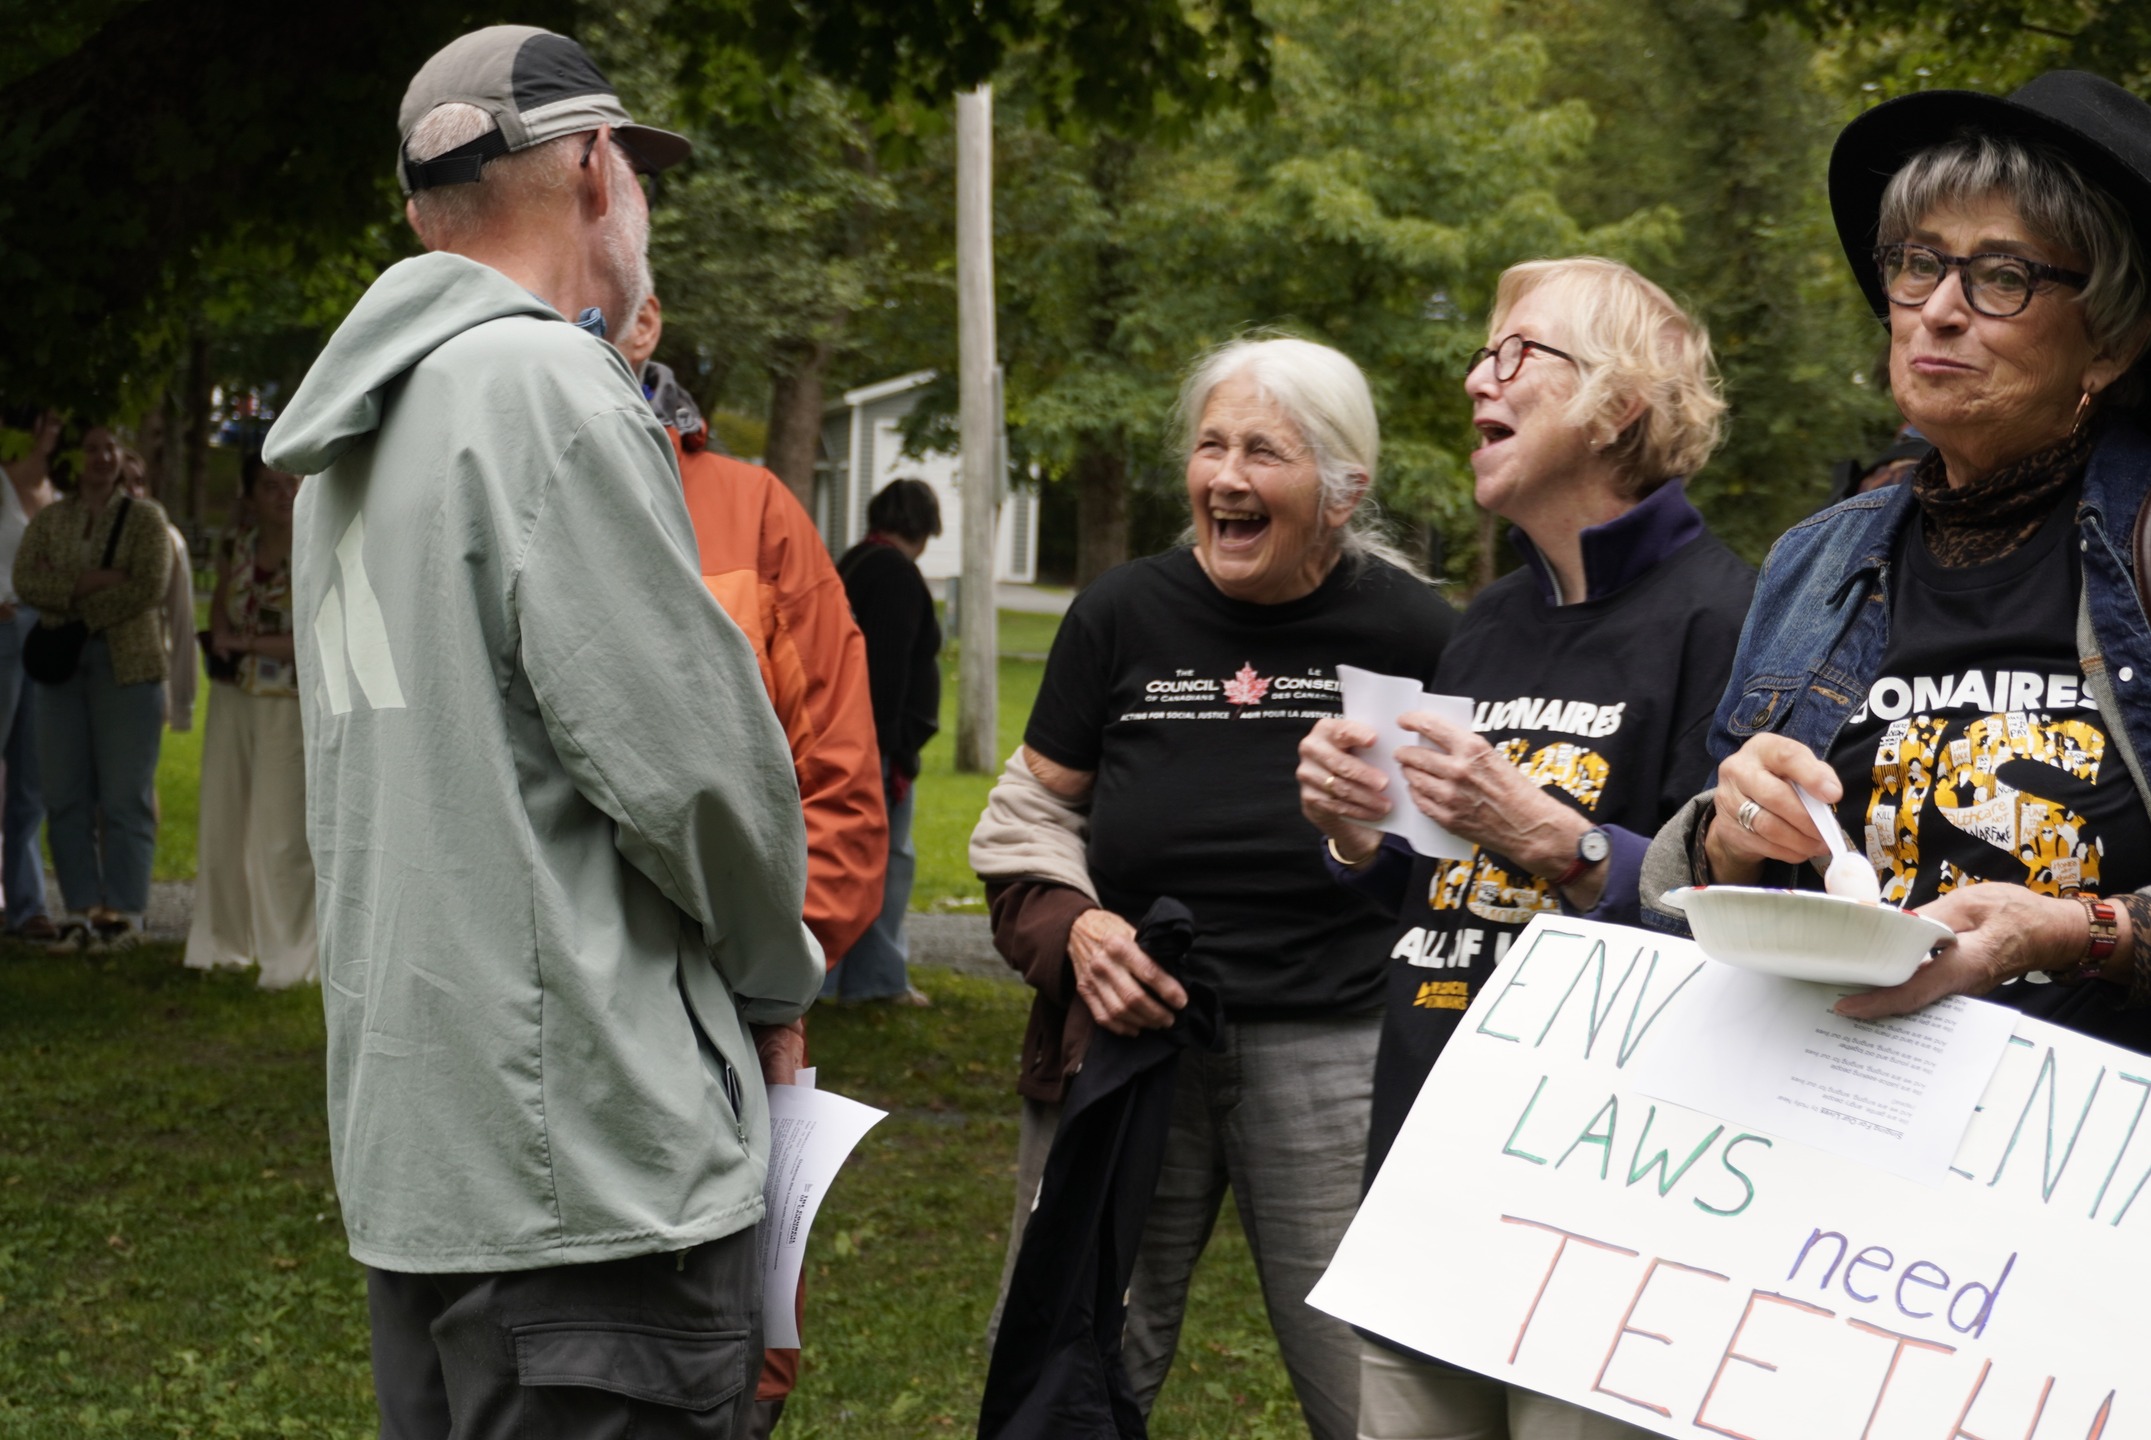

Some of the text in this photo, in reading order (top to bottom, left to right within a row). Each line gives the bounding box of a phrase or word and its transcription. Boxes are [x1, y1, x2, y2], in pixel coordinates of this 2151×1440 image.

[1175, 669, 1195, 677] THE
[1308, 667, 1321, 676] LE
[1146, 679, 1220, 693] COUNCIL
[1160, 694, 1215, 702] CANADIANS
[1120, 711, 1230, 721] ACTING FOR SOCIAL JUSTICE
[1239, 711, 1260, 719] AGIR
[1263, 710, 1285, 718] POUR
[1287, 710, 1299, 718] LA
[1300, 711, 1332, 719] JUSTICE
[1876, 811, 1891, 820] KILL
[1992, 814, 2008, 823] NOT
[1390, 927, 1448, 968] ALL
[1814, 1027, 1829, 1036] lives
[1829, 1031, 1841, 1039] our
[1850, 1036, 1874, 1048] singing
[1803, 1048, 1819, 1057] lives
[1840, 1057, 1864, 1070] singing
[1502, 1075, 1772, 1216] LAWS
[1787, 1227, 2017, 1339] need
